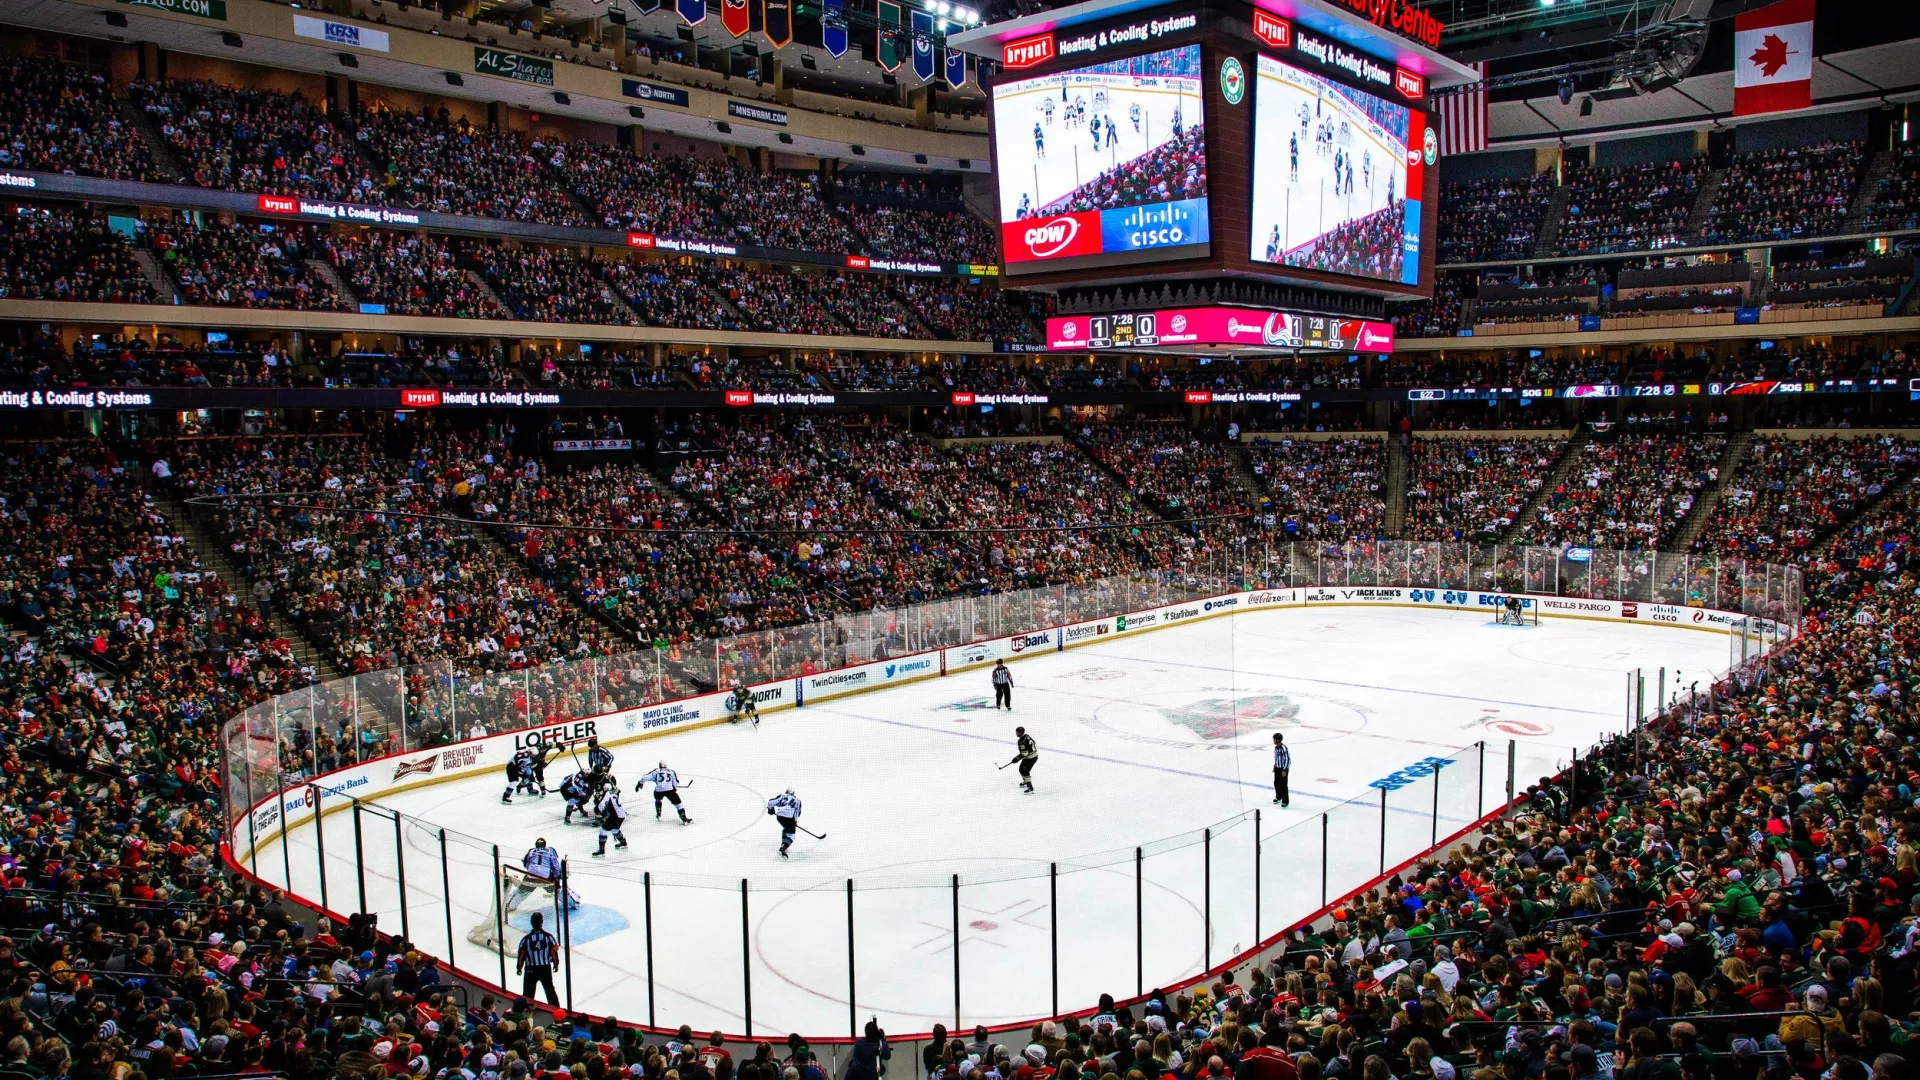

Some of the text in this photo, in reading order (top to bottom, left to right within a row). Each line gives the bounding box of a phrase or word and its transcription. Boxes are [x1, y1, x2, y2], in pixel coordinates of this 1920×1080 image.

[1059, 15, 1196, 55] Heating & Cooling Systems
[1258, 15, 1285, 42] bryant
[1007, 41, 1047, 63] bryant
[1297, 32, 1391, 85] Heating & Cooling Systems
[477, 51, 553, 77] Al Shaver
[511, 71, 553, 85] PRESS BOX
[1399, 74, 1419, 96] bryant
[653, 90, 675, 100] NORTH
[265, 199, 293, 210] bryant
[300, 202, 419, 224] Heating & Cooling Systems
[1024, 224, 1065, 246] CDW
[1131, 227, 1183, 247] CISCO
[655, 238, 736, 255] Heating & Cooling Systems
[869, 259, 941, 273] Heating & Cooling Systems
[1112, 314, 1133, 325] 7:28
[1140, 317, 1152, 335] 0
[1309, 317, 1324, 330] 7:28
[1094, 320, 1103, 337] 1
[1115, 326, 1132, 335] 2ND
[1293, 320, 1299, 337] 1
[1331, 321, 1338, 340] 0
[1025, 344, 1048, 352] Wealth
[1521, 389, 1542, 397] SOG
[1635, 386, 1661, 396] 7:28
[1711, 385, 1719, 394] 0
[1780, 384, 1802, 392] SOG
[32, 391, 43, 405] &
[46, 391, 94, 408] Cooling
[97, 391, 151, 408] Systems
[408, 393, 435, 405] bryant
[442, 392, 560, 406] Heating & Cooling Systems
[753, 393, 835, 405] Heating & Cooling Systems
[974, 394, 1049, 404] Heating & Cooling Systems
[1212, 392, 1301, 403] Heating & Cooling Systems
[1376, 589, 1402, 597] LINK'S
[1213, 598, 1238, 608] POLARIS
[1479, 594, 1531, 608] ECOB
[1543, 600, 1611, 612] WELLS FARGO
[1119, 614, 1156, 627] enterprise
[1653, 614, 1677, 622] CISCO
[1707, 614, 1725, 623] Xcel
[1065, 624, 1096, 638] Andersen
[899, 659, 931, 673] @MNWILD
[751, 687, 782, 704] NORTH
[642, 709, 662, 721] MAYO
[662, 704, 684, 717] CLINIC
[643, 717, 669, 730] SPORTS
[669, 710, 700, 723] MEDICINE
[515, 720, 597, 751] LOFFLER
[442, 744, 484, 761] BREWED THE
[393, 757, 438, 776] Budweiser
[443, 755, 477, 771] HARD WAY
[321, 775, 369, 799] Harris Bank
[258, 804, 278, 821] DOWNLOAD
[285, 798, 304, 813] BMO
[257, 812, 279, 832] THE APP
